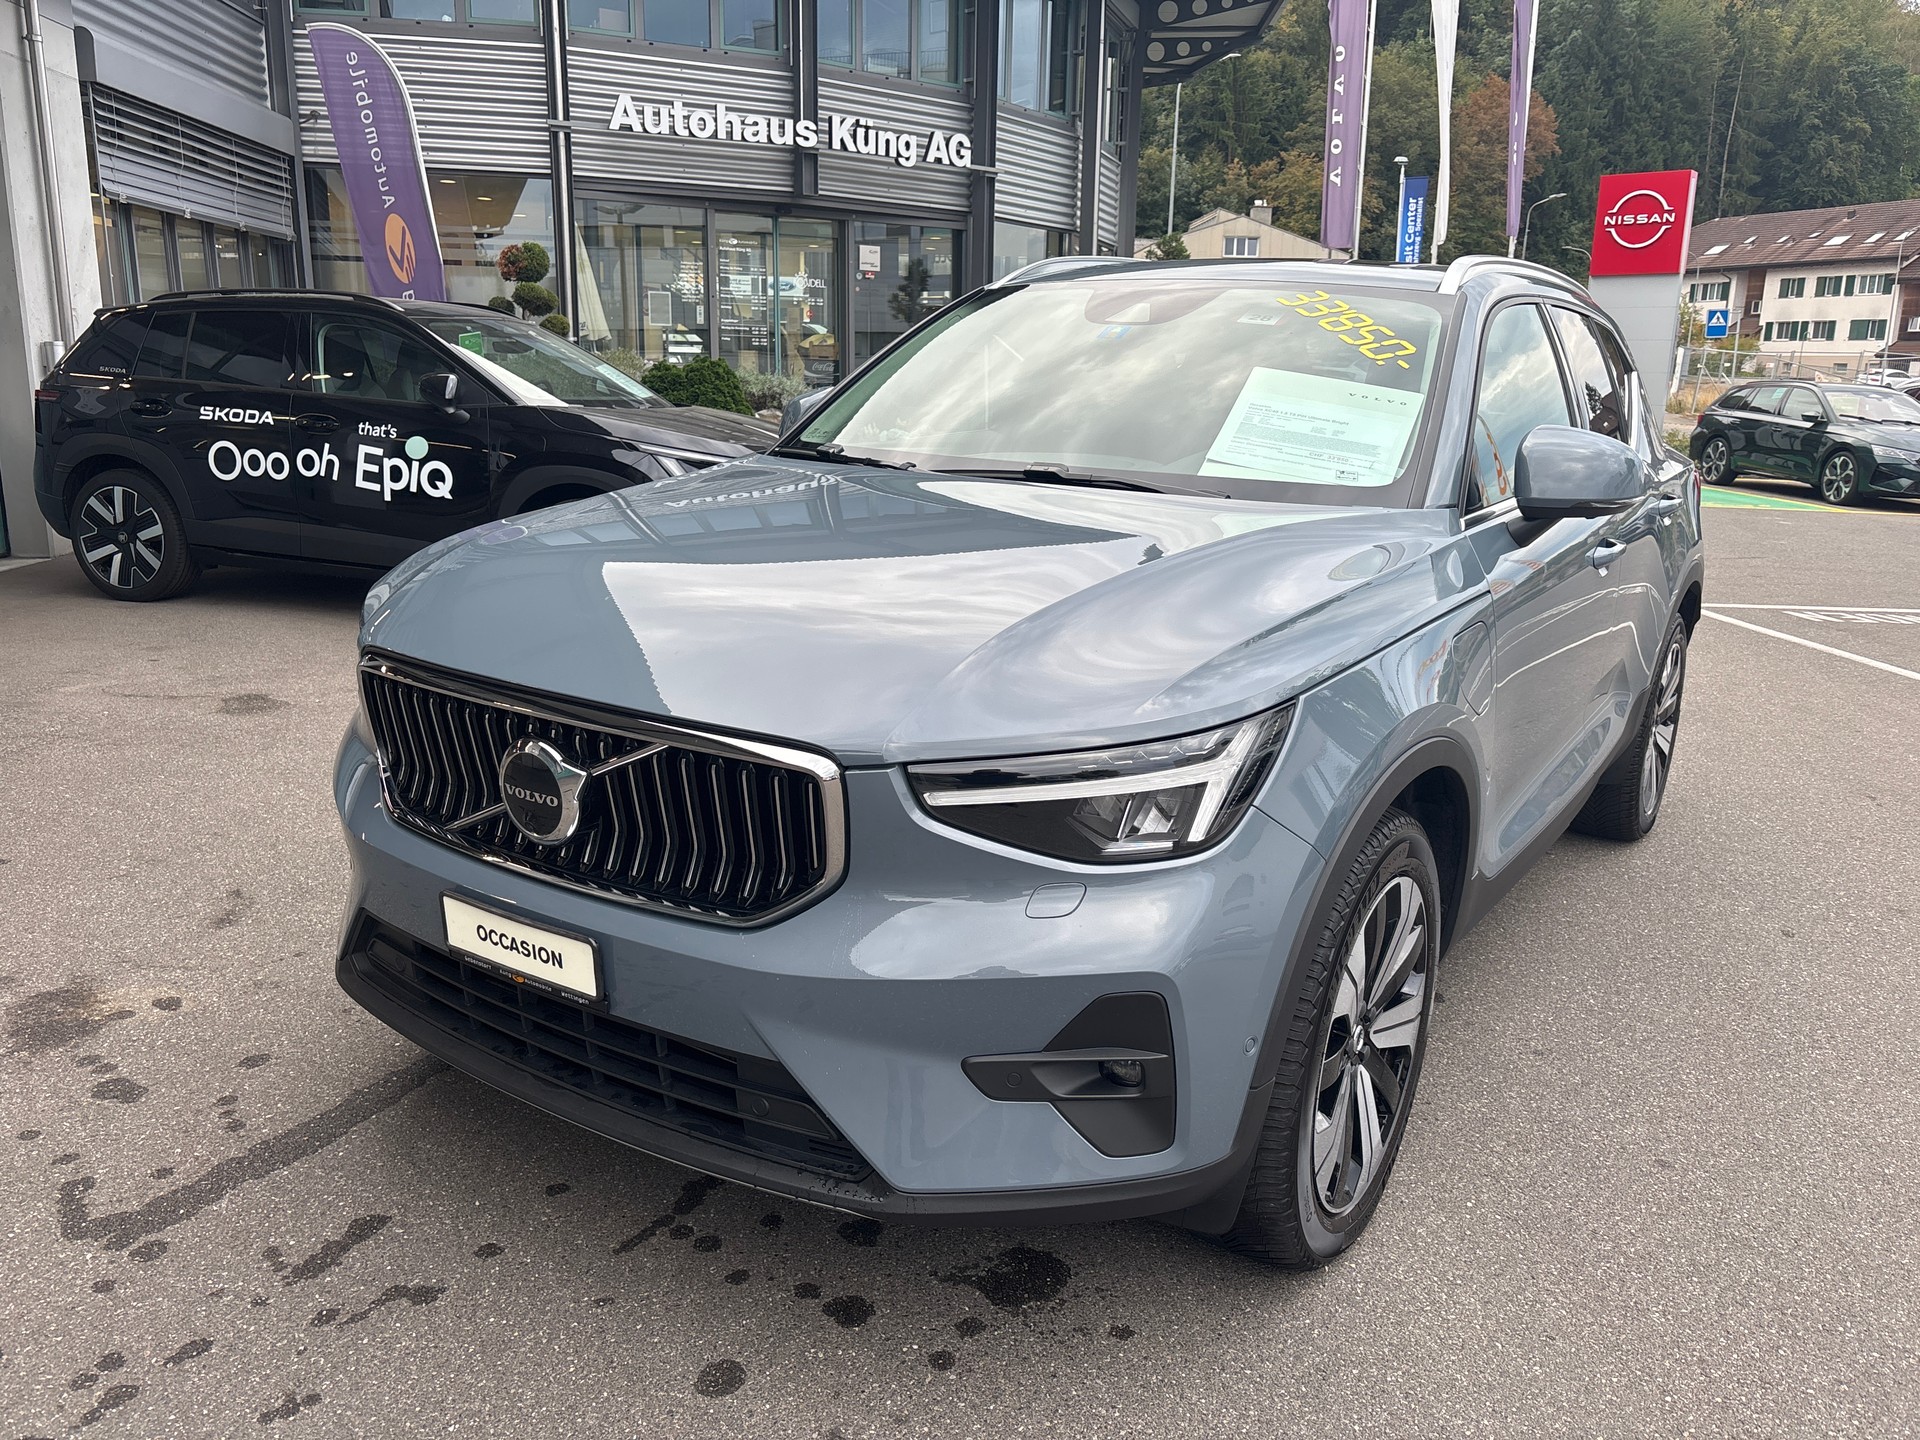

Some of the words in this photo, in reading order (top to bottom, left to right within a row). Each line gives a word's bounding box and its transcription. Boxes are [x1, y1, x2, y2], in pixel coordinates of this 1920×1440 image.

[607, 92, 818, 148] Autohaus
[828, 114, 917, 168] Küng
[925, 129, 972, 168] AG
[1404, 197, 1417, 243] Center
[1603, 212, 1676, 226] NISSAN
[1348, 392, 1408, 406] VOLVO
[358, 421, 398, 439] that's
[296, 442, 340, 482] oh
[355, 435, 454, 502] EpiQ
[504, 782, 559, 808] VOLVO
[476, 924, 564, 970] OCCASION
